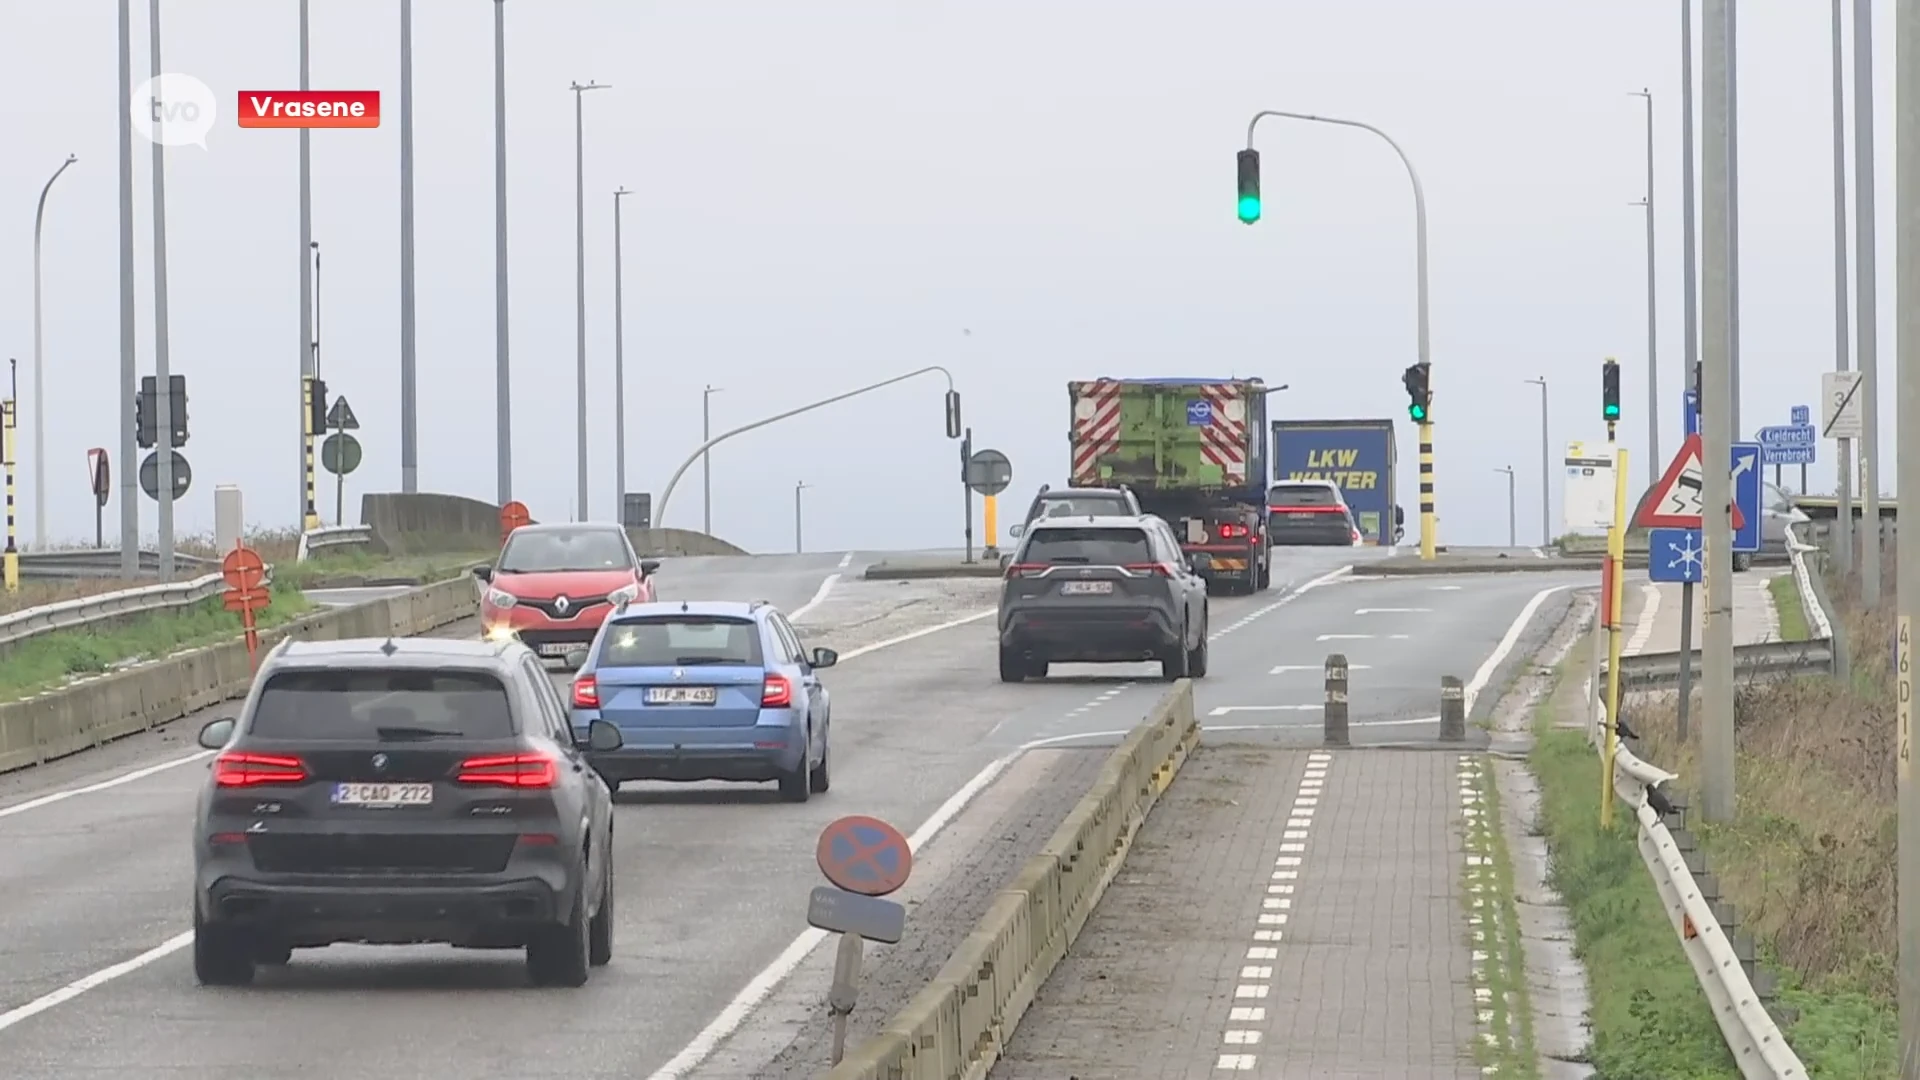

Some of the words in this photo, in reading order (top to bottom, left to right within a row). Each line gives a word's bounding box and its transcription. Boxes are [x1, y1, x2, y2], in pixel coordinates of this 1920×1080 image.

[1766, 428, 1810, 442] Kieldrecht
[1307, 449, 1358, 468] LKW
[1764, 448, 1812, 462] Verrebroek
[1899, 623, 1910, 763] 46D14
